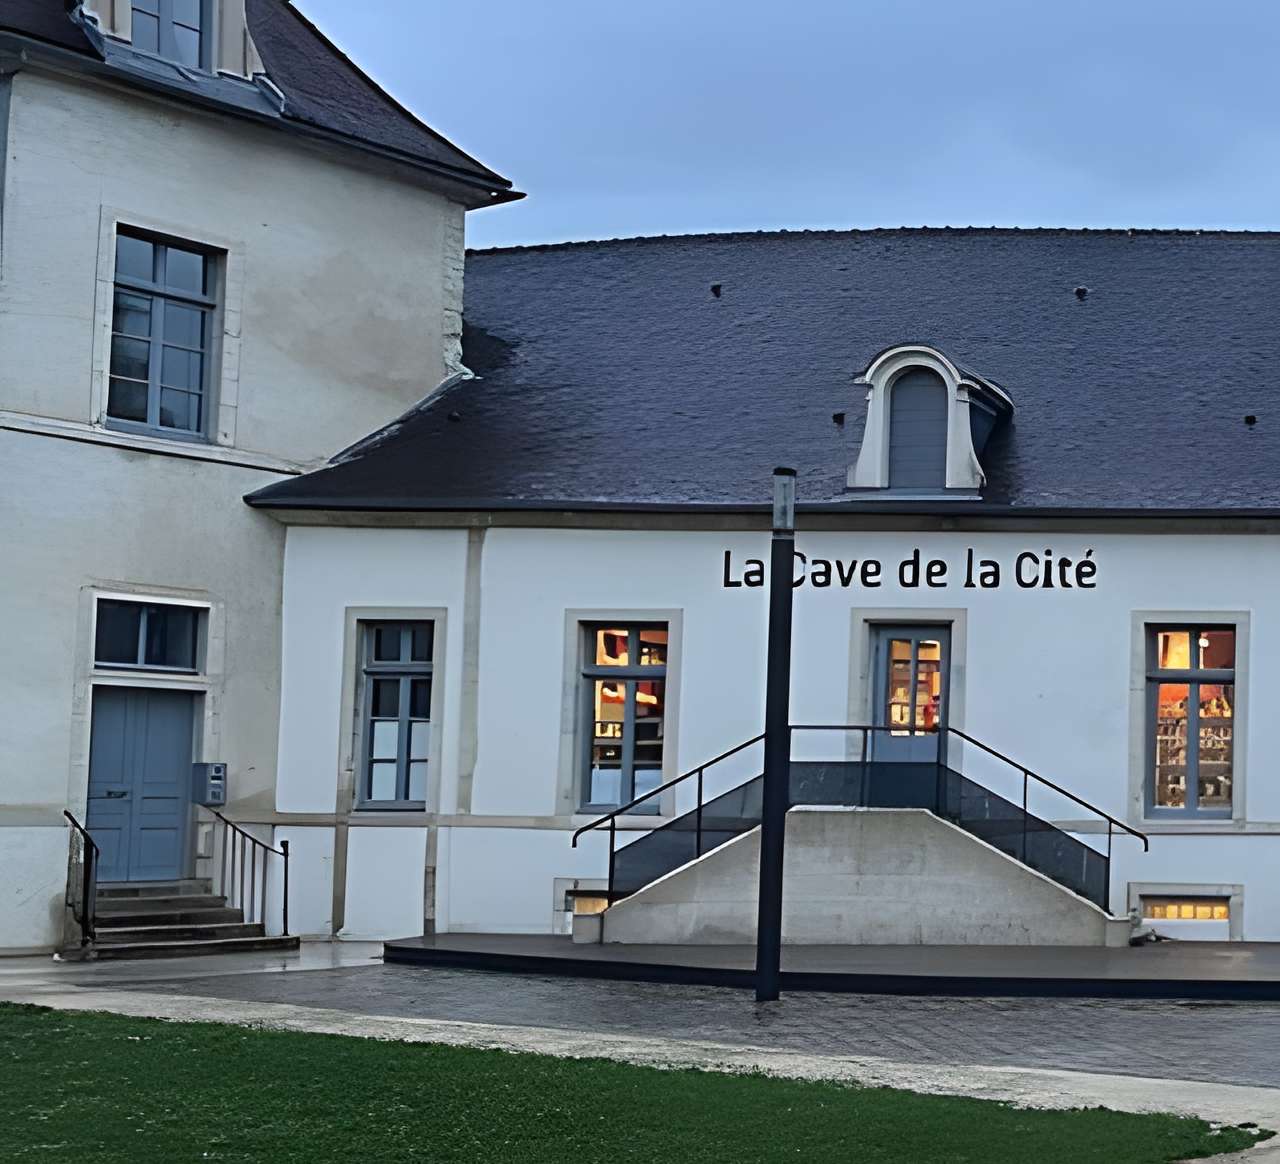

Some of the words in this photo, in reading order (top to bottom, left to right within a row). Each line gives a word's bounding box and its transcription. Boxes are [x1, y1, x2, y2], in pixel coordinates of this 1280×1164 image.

[723, 550, 765, 588] La
[792, 551, 882, 588] Cave
[898, 548, 948, 588] de
[963, 547, 1001, 588] la
[1015, 548, 1098, 589] Cité
